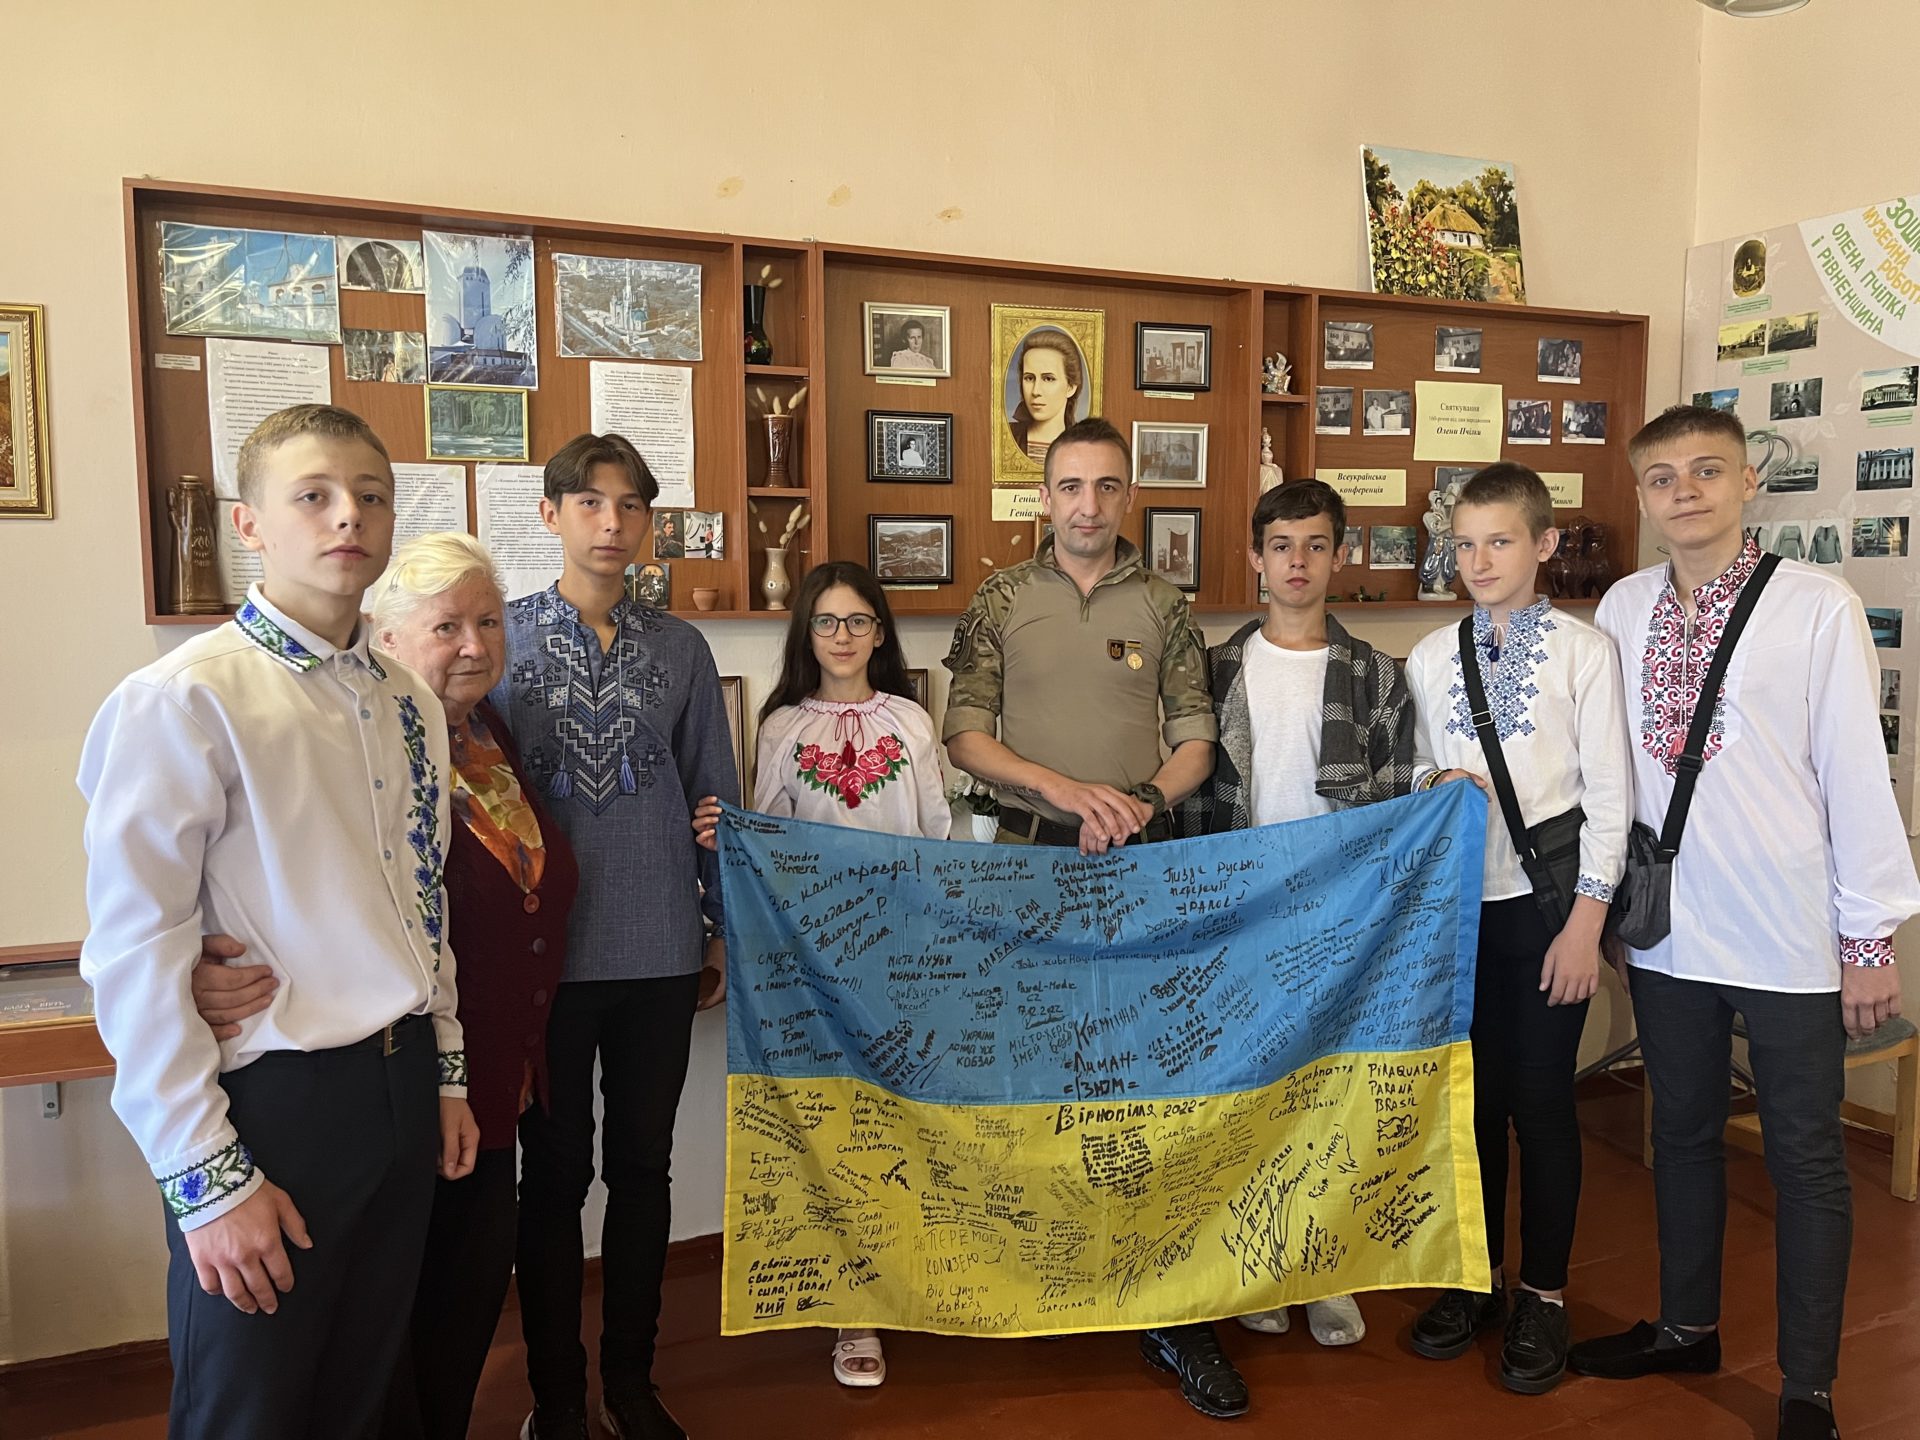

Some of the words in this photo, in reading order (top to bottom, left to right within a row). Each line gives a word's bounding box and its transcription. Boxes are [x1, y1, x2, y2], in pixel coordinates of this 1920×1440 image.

[1832, 223, 1865, 273] ОЛЕНА
[1440, 403, 1480, 413] Святкування
[1337, 472, 1387, 482] Всеукраїнська
[1339, 486, 1384, 495] конференція
[956, 1055, 996, 1068] КОБЗАР
[850, 1128, 884, 1146] MIRON
[991, 1184, 1025, 1196] СЛАВА
[761, 1255, 793, 1271] своїй
[755, 1298, 786, 1315] КИЙ
